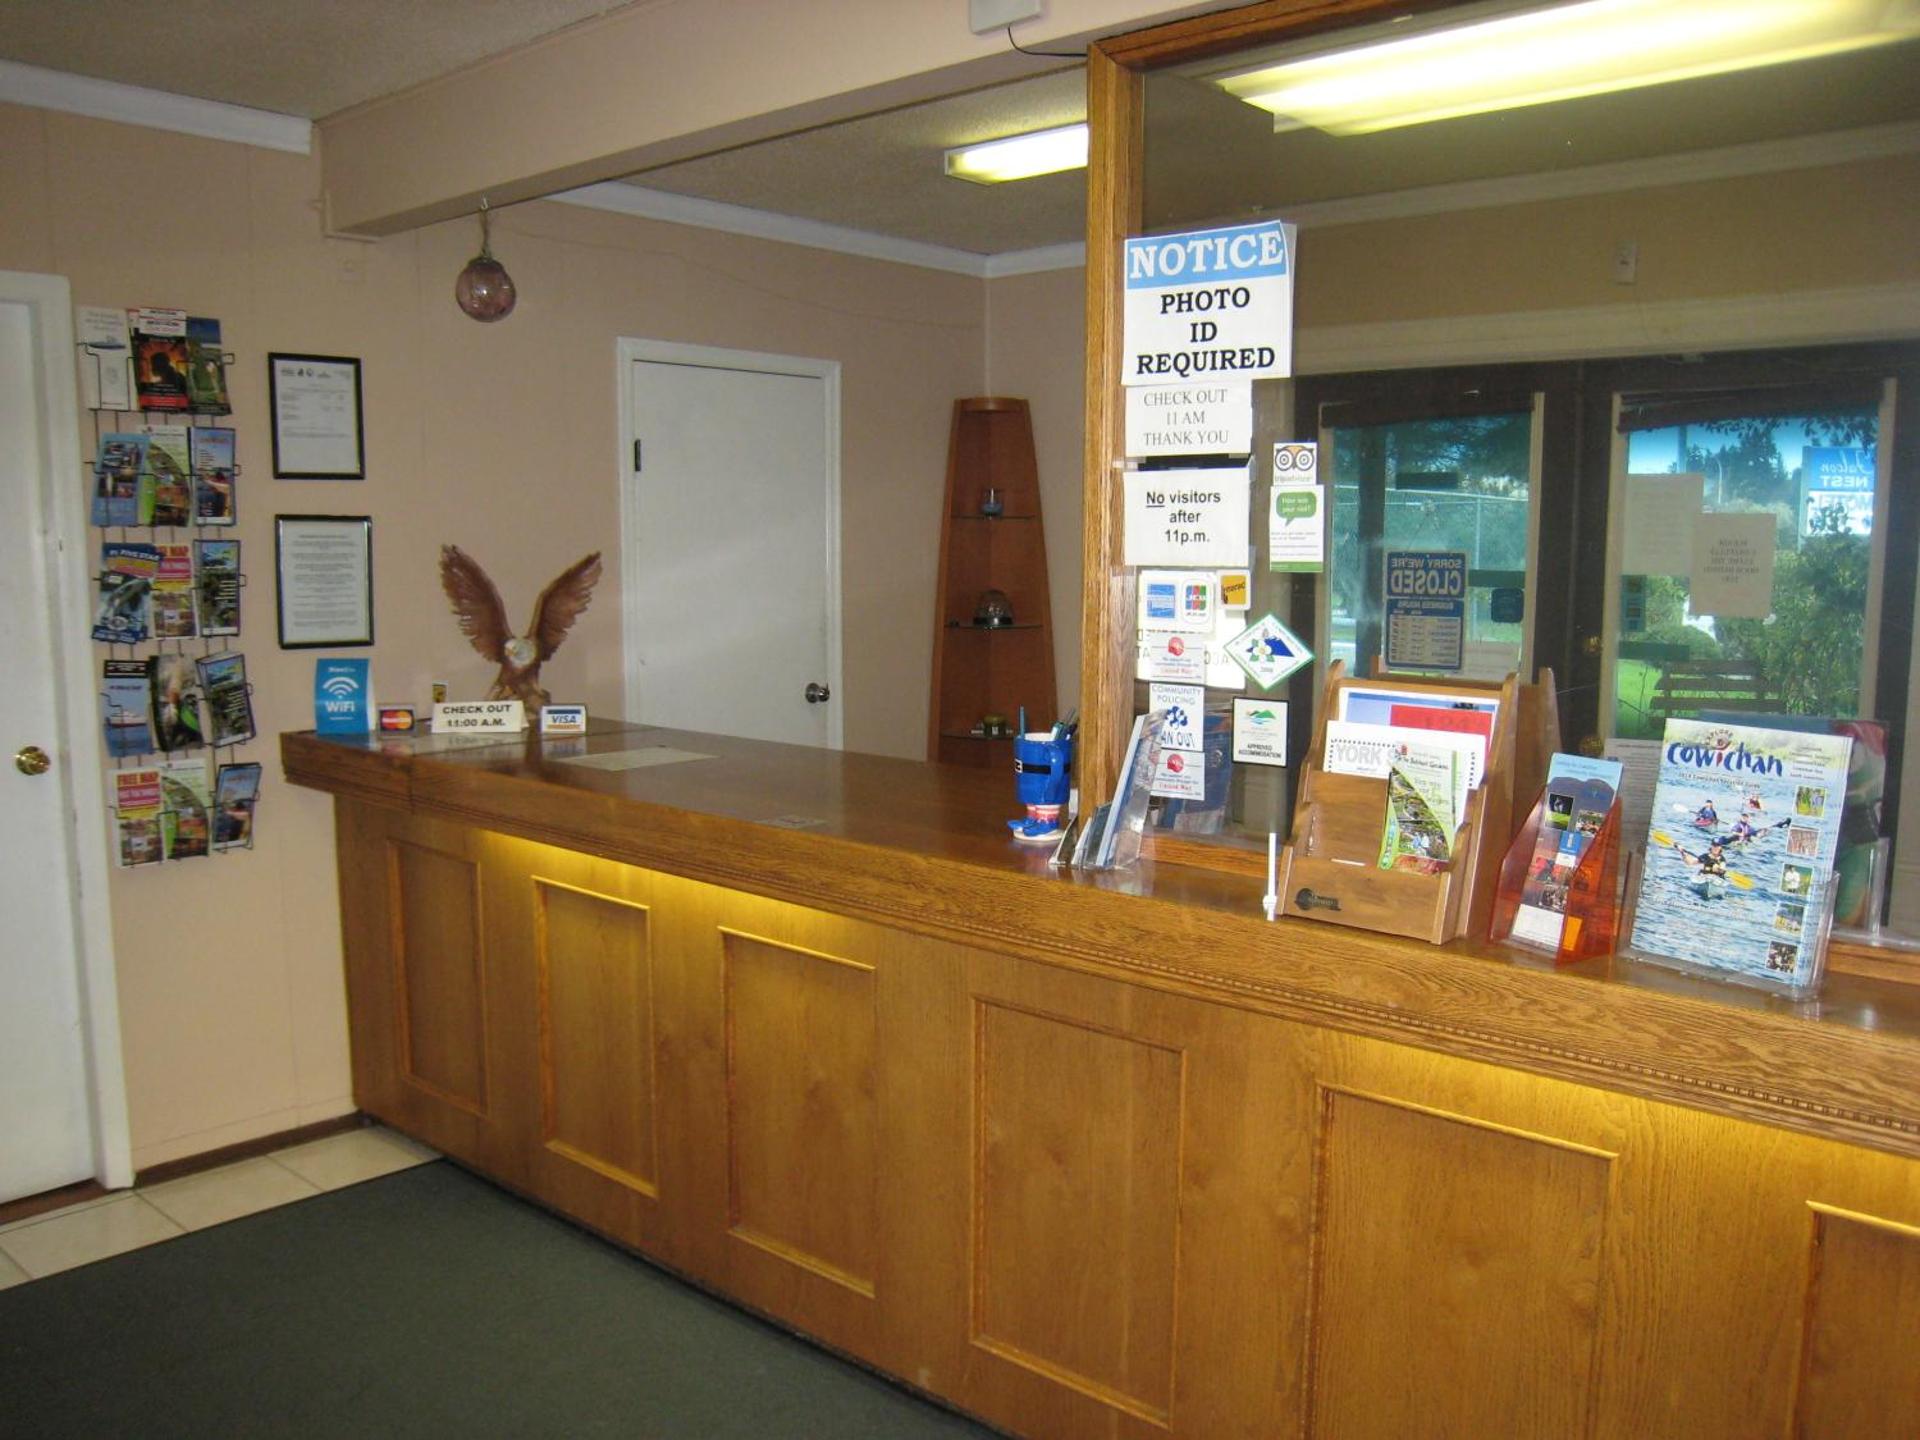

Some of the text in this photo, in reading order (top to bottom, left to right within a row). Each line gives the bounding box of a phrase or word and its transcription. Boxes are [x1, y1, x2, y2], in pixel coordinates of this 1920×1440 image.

[1129, 230, 1284, 279] NOTICE
[1160, 287, 1251, 315] PHOTO
[1190, 321, 1218, 343] ID
[1136, 346, 1276, 378] REQUIRED
[1143, 388, 1228, 407] CHECK OUT
[1166, 410, 1206, 425] 11 AM
[1143, 430, 1229, 447] THANK YOU
[1146, 490, 1221, 507] No visitors
[1169, 509, 1201, 524] after
[1165, 529, 1211, 544] 11p.m.
[1151, 684, 1202, 698] COMMUNITY
[442, 703, 512, 715] CHECK OUT
[446, 717, 506, 728] 11:00 A.M.
[550, 715, 577, 725] VISA
